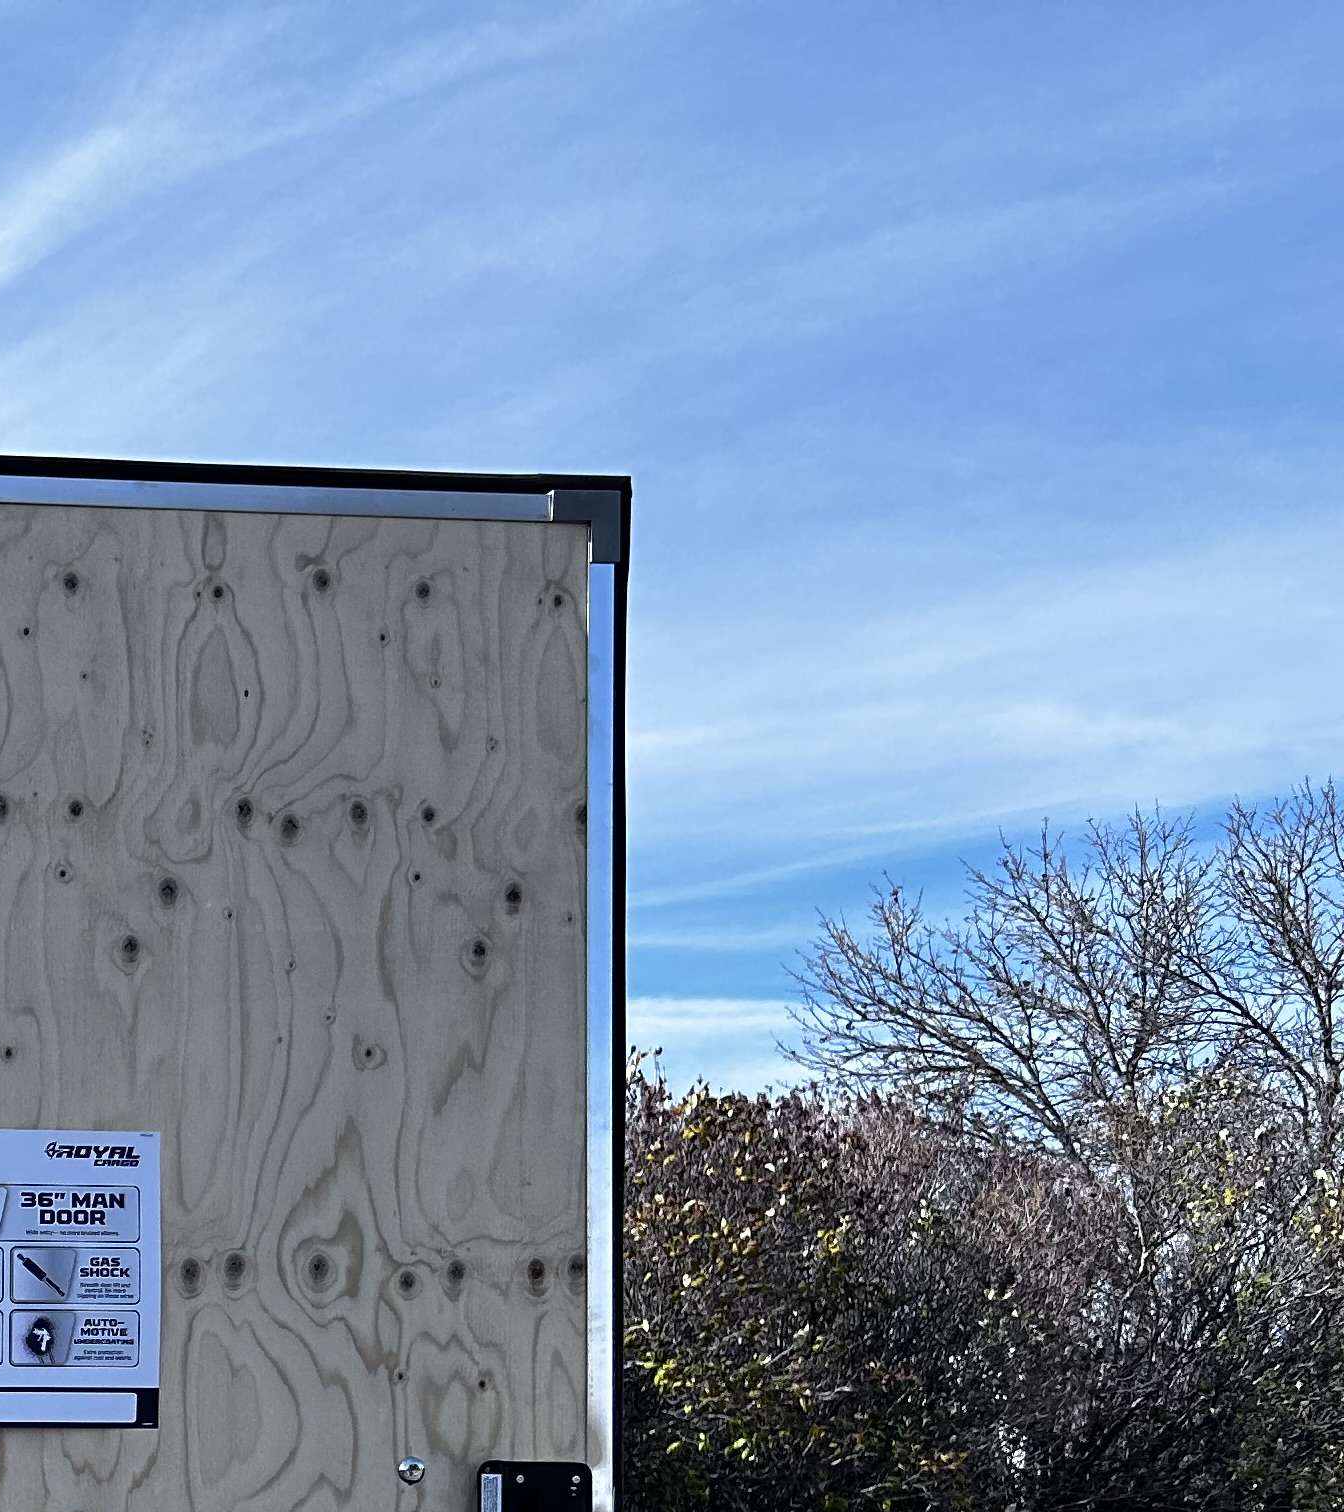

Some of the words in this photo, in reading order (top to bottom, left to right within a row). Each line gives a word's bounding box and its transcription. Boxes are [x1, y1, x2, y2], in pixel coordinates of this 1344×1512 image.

[55, 1145, 141, 1160] ROYAL
[93, 1159, 140, 1167] CARGO
[20, 1191, 66, 1208] 36"
[71, 1192, 126, 1209] MAN
[39, 1209, 106, 1225] DOOR
[89, 1256, 121, 1267] GAS
[79, 1267, 130, 1278] SHOCK
[83, 1318, 125, 1327] AUTO-
[80, 1327, 128, 1337] MOTIVE
